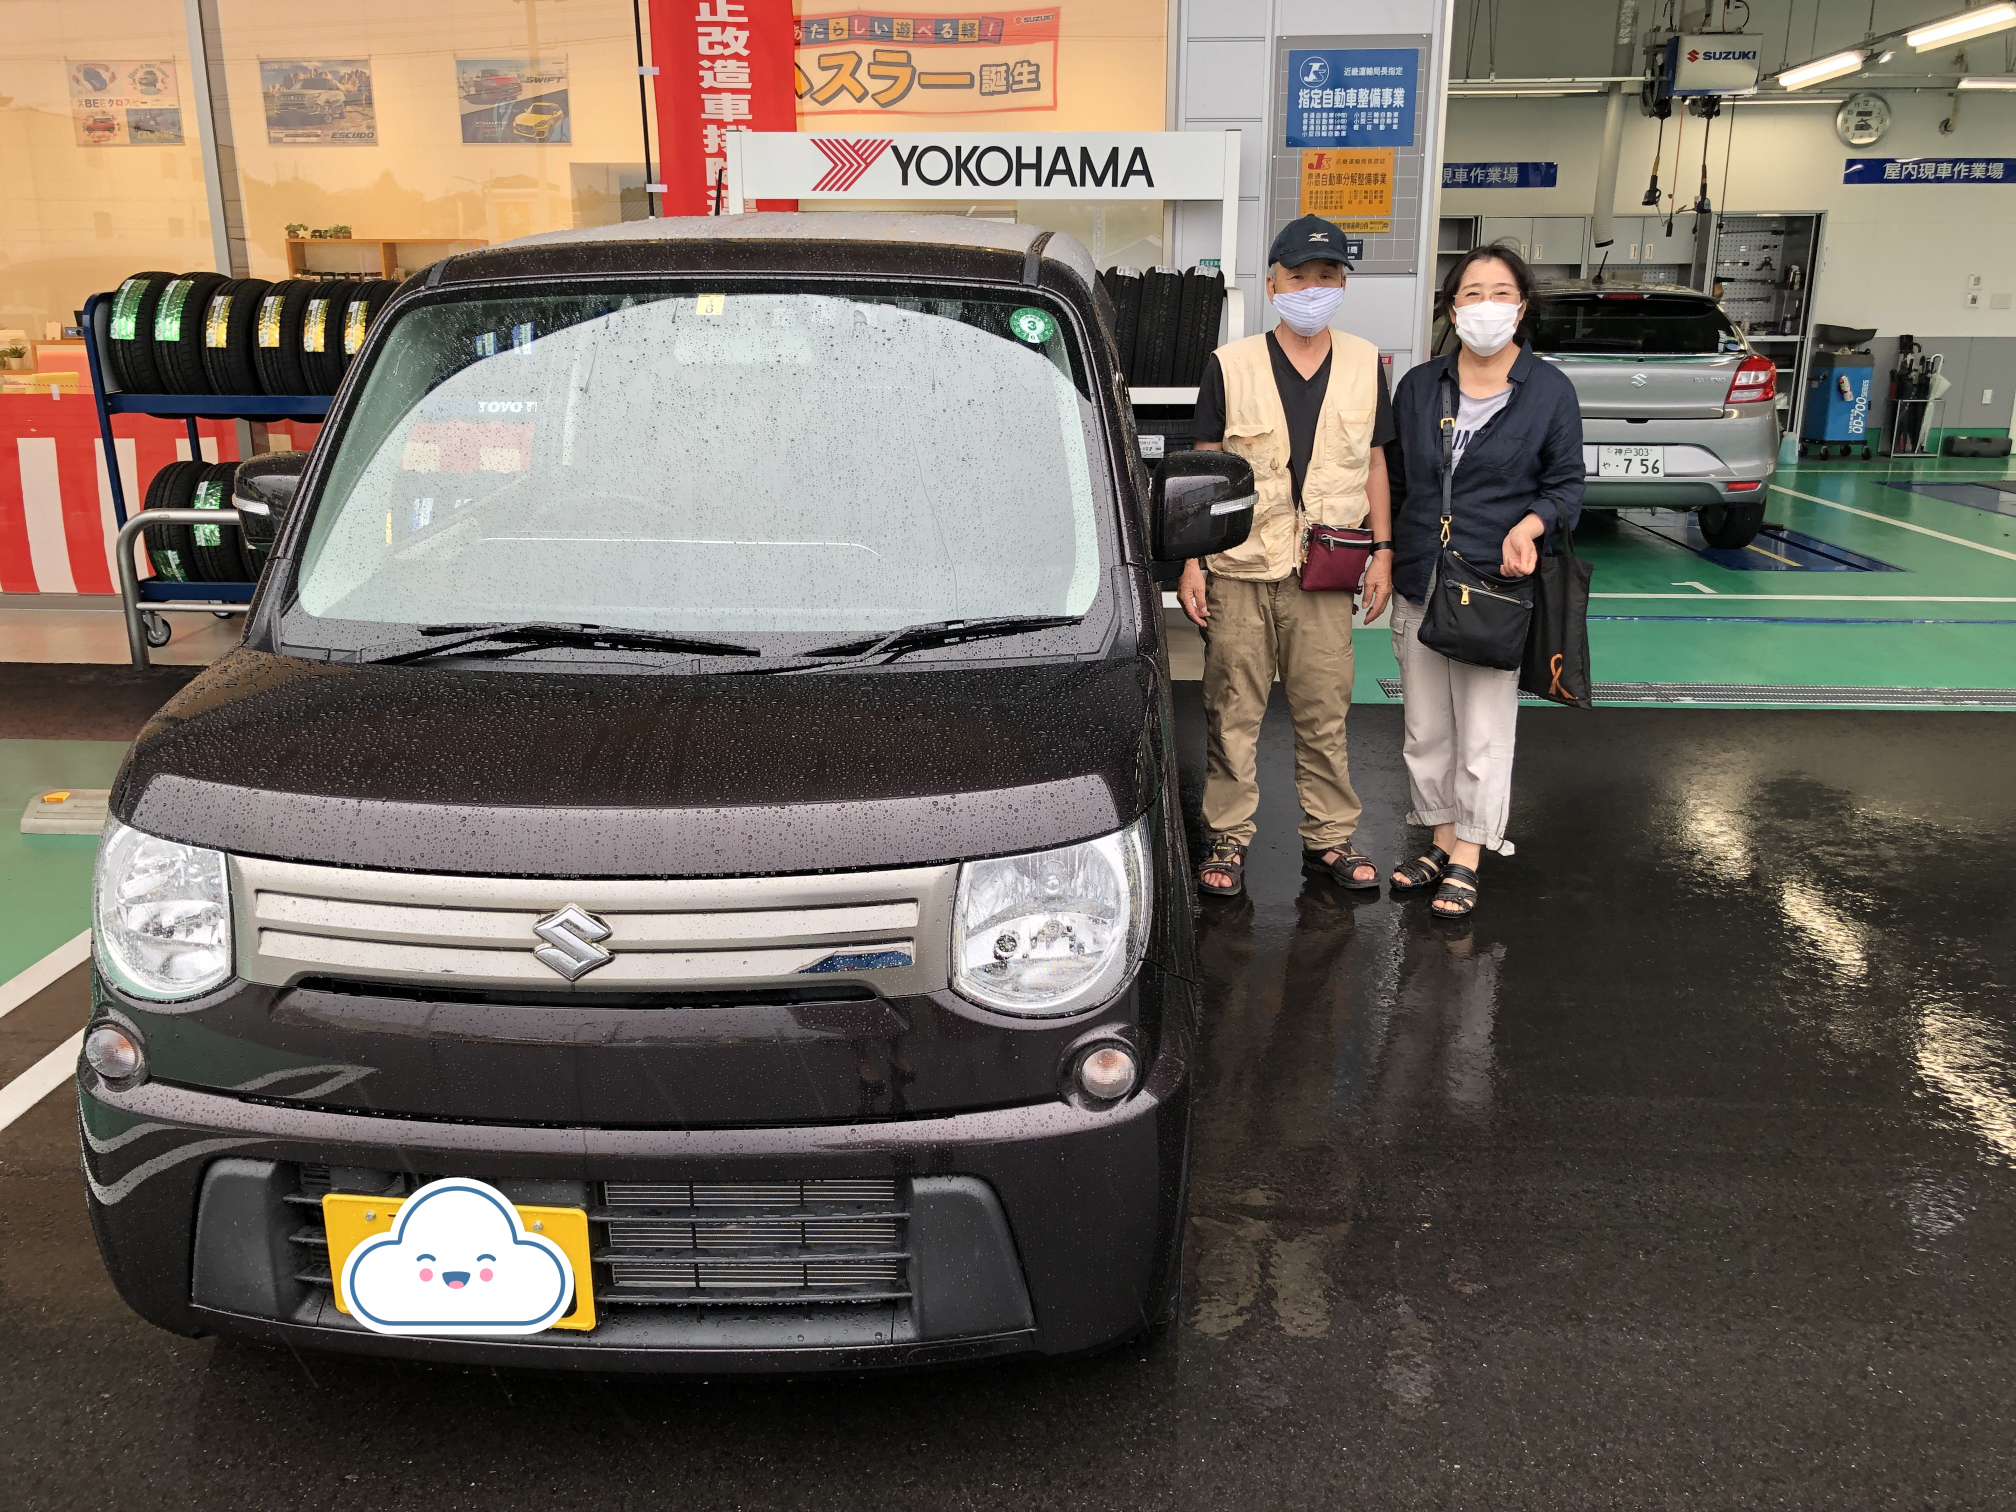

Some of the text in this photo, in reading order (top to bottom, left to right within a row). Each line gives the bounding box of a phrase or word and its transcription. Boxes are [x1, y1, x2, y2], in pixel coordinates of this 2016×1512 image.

[1023, 14, 1054, 23] SUZUKI
[1702, 50, 1757, 60] SUZUKI
[526, 76, 564, 84] SWIFT
[1298, 87, 1406, 109] 指定自動車整備事業
[890, 145, 1155, 188] YOKOHAMA
[1883, 162, 2005, 180] 屋内現車作業場
[1027, 320, 1037, 331] 3
[477, 401, 524, 413] TOYO
[1852, 396, 1867, 434] OD-700
[1602, 462, 1611, 470] や
